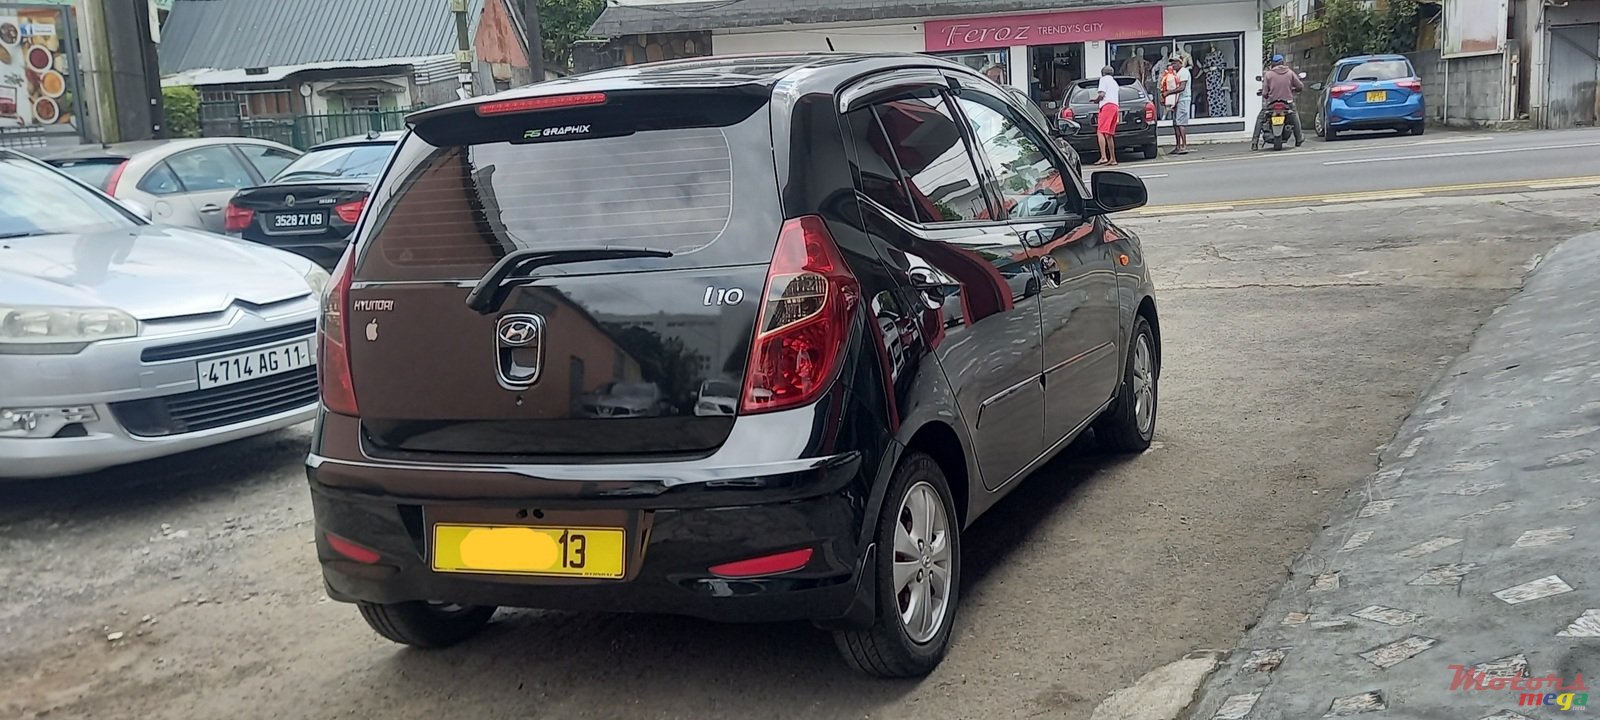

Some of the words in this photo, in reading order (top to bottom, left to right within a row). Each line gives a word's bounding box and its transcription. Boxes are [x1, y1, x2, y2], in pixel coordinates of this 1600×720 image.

[941, 23, 1031, 47] Feroz
[1037, 24, 1081, 35] TRENDY'S
[1083, 22, 1104, 33] CITY
[542, 124, 591, 136] GRAPHIX
[274, 214, 298, 227] 3528
[298, 213, 310, 226] ZY
[310, 213, 323, 225] 09
[353, 299, 394, 311] HYUNDAI
[208, 356, 254, 384] 4714
[259, 350, 279, 374] AG
[284, 345, 301, 368] 11
[558, 529, 586, 569] 13
